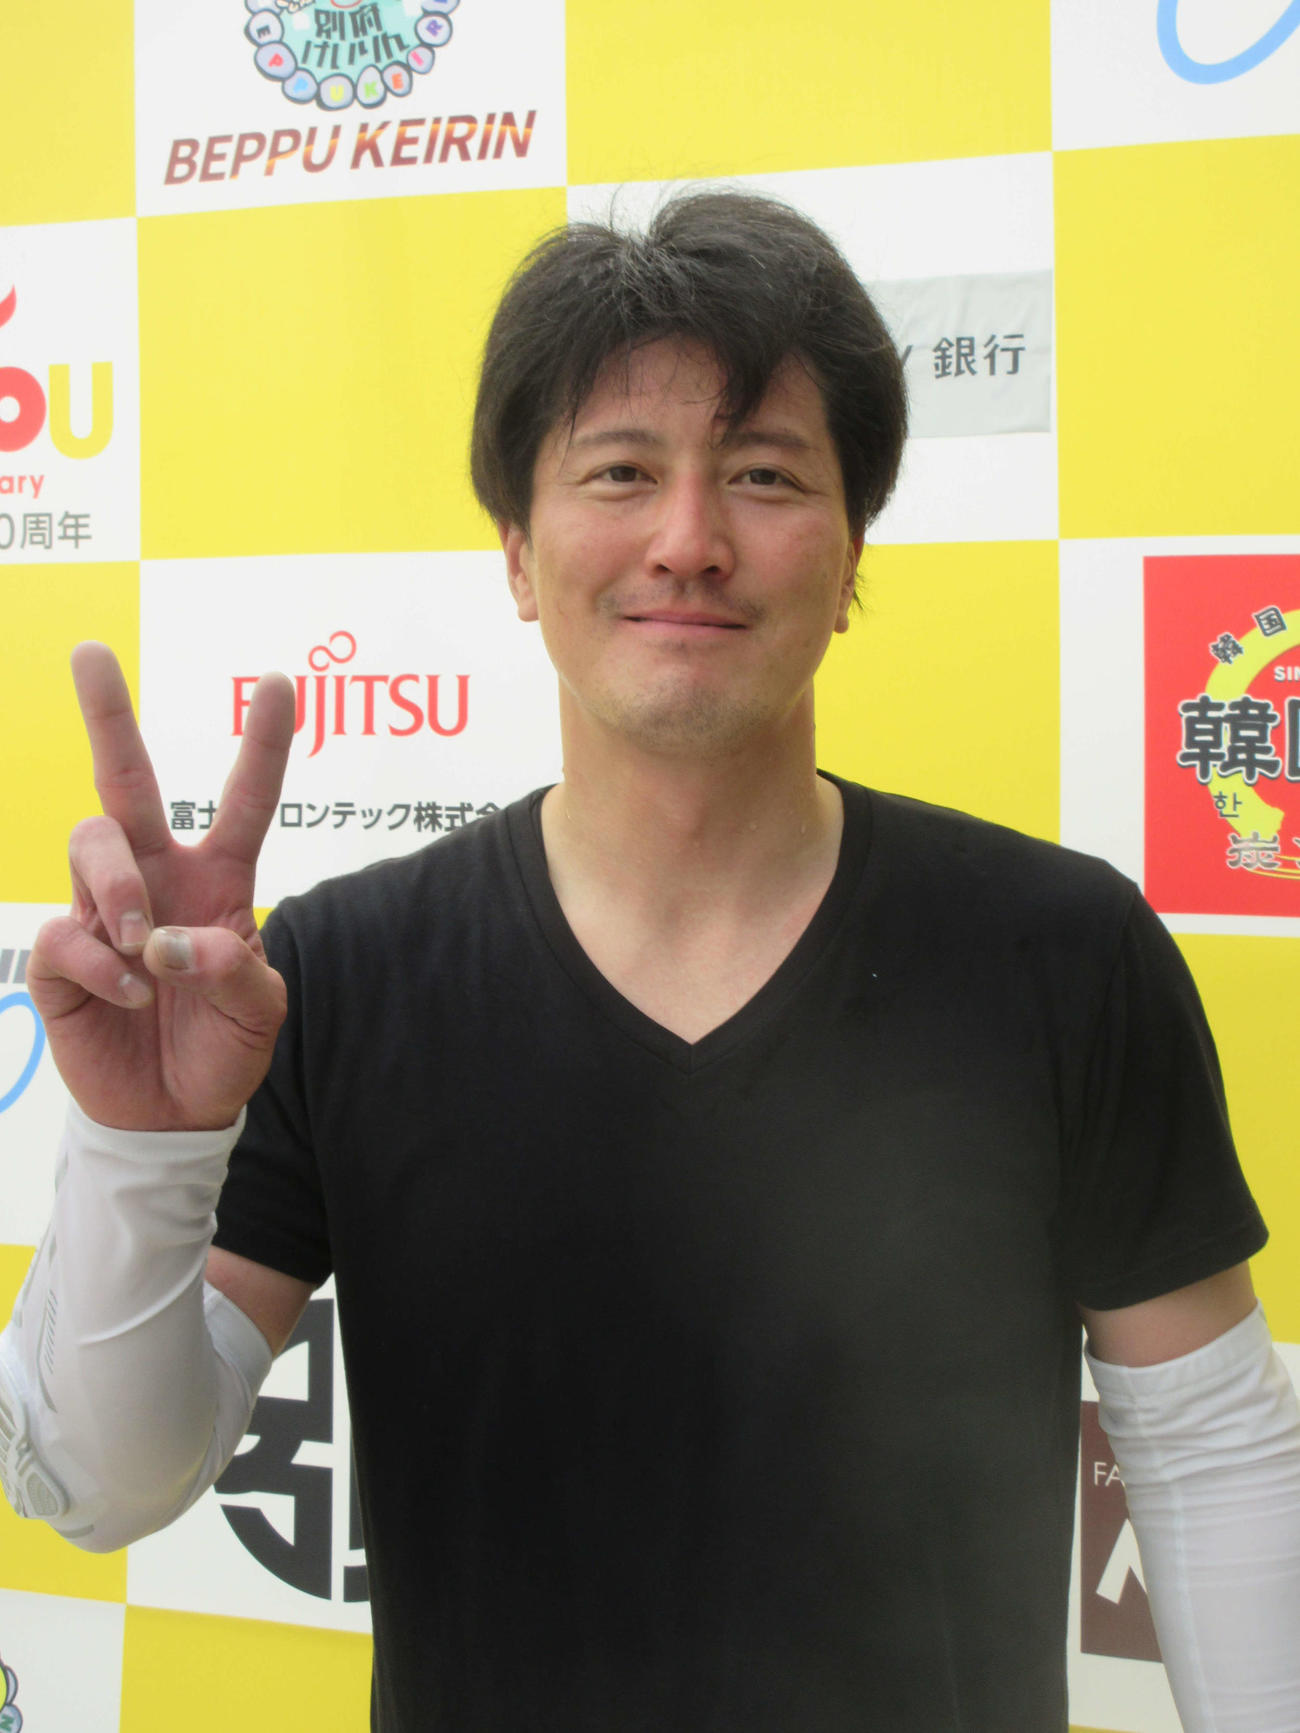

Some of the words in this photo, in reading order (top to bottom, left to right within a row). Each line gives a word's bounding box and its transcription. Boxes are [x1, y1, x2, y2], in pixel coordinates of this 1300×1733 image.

[163, 124, 342, 185] BEPPU
[350, 110, 537, 170] KEIRIN
[932, 333, 1026, 379] 銀行
[1177, 694, 1300, 787] 韓
